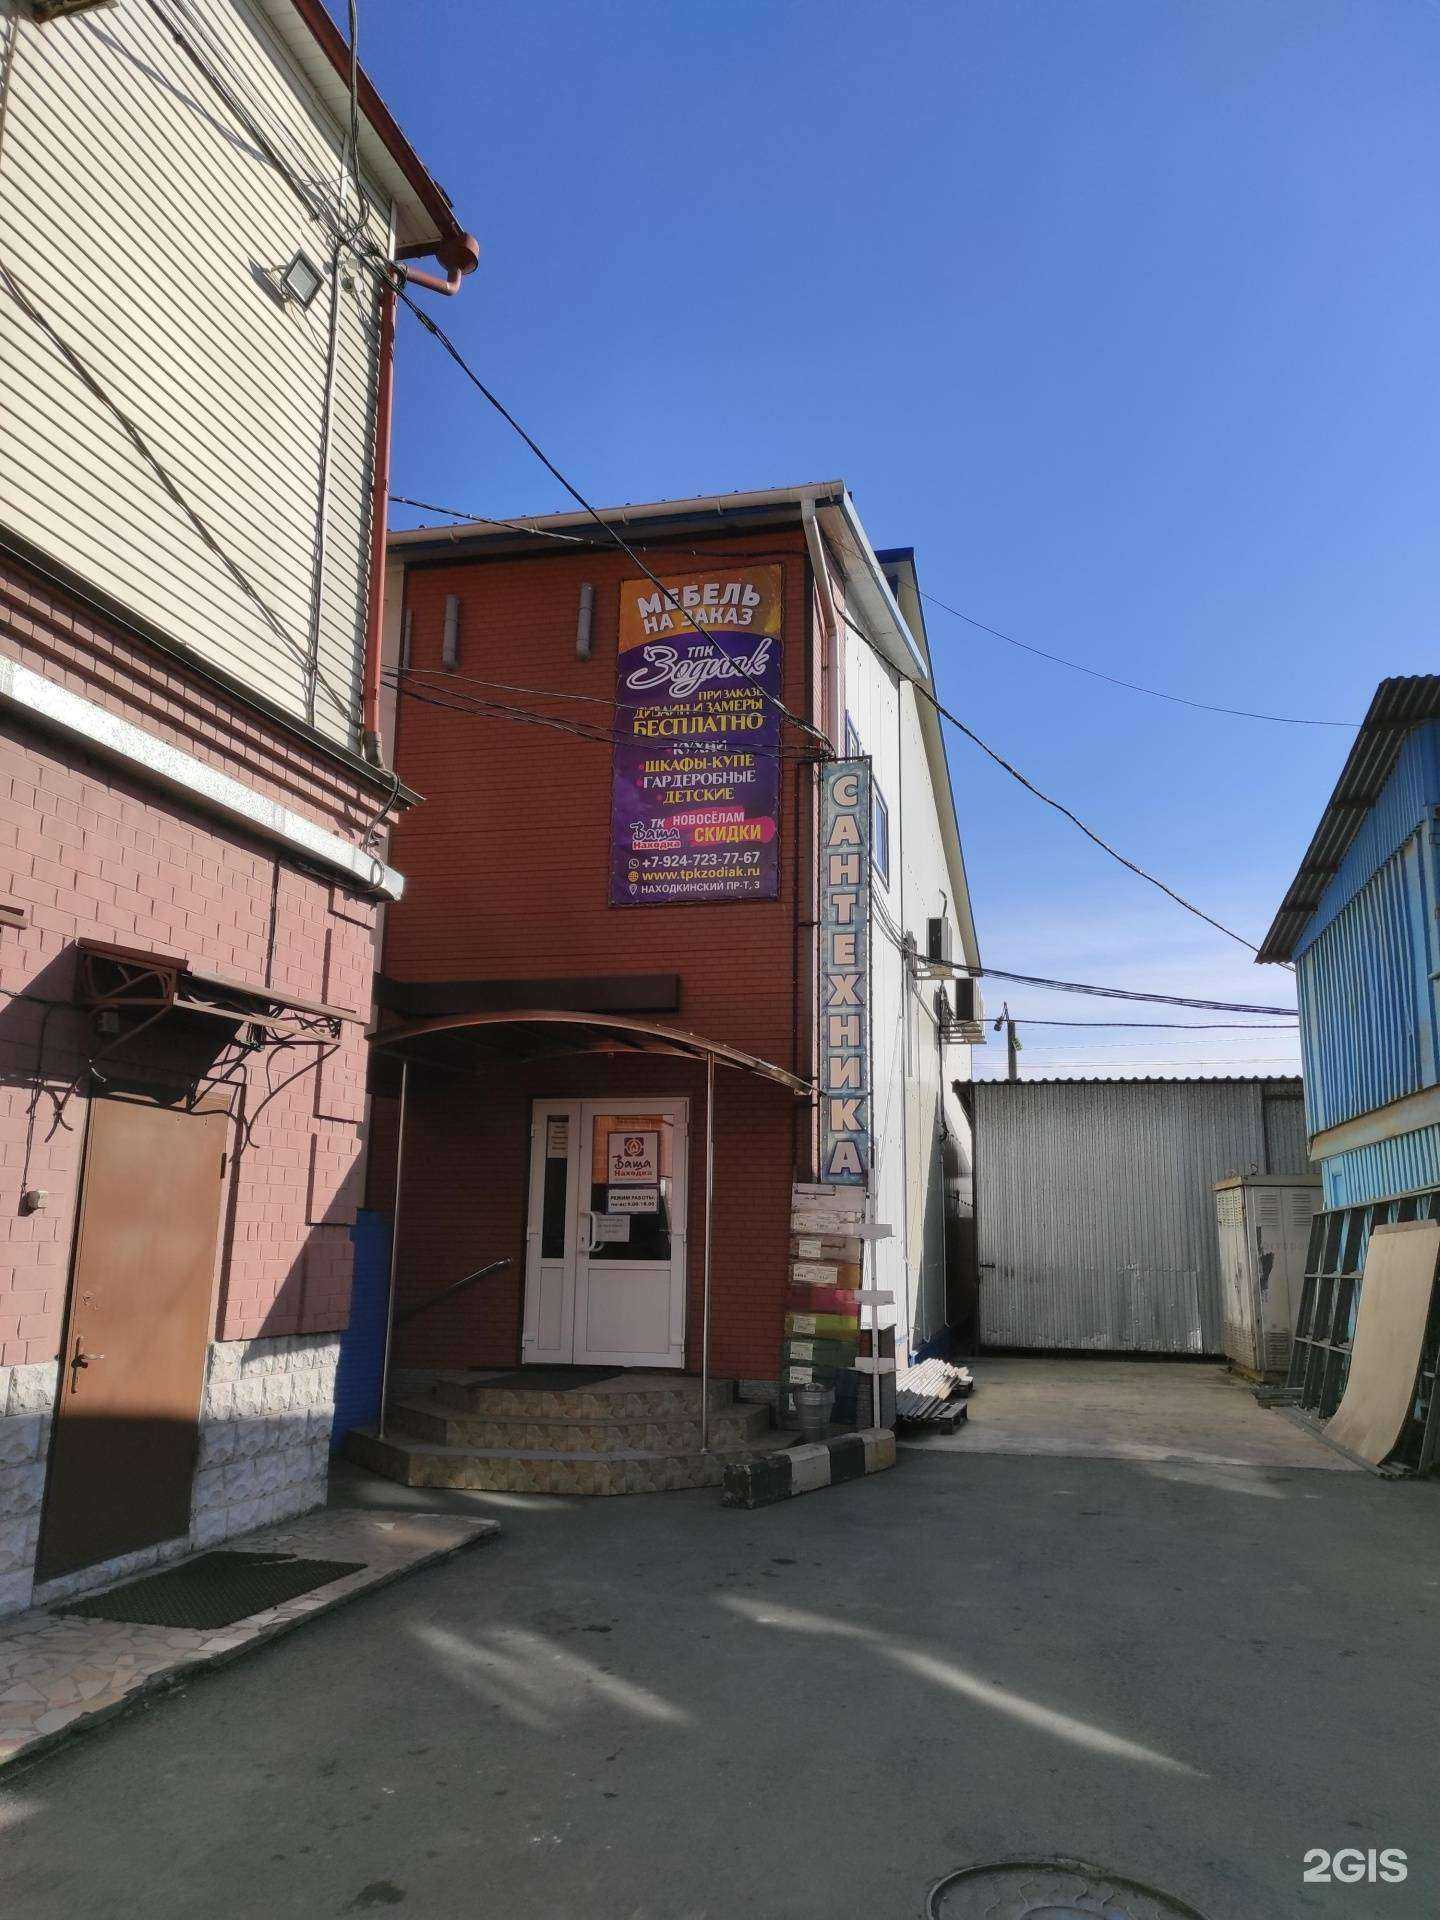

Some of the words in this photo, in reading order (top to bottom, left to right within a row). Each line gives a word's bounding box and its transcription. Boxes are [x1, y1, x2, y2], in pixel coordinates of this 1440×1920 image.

[637, 583, 761, 618] МЕБЕЛЬ
[644, 613, 674, 635] НА
[681, 608, 753, 628] ЗАКАЗ
[687, 645, 714, 659] ТПК
[697, 691, 722, 701] ПРИ
[724, 688, 764, 699] ЗАКАЗЕ
[693, 703, 702, 714] И
[706, 698, 763, 713] ЗАМЕРЫ
[633, 713, 765, 737] БЕСПЛАТНО
[644, 754, 755, 773] ШКАФЫ-КУПЕ
[643, 770, 756, 789] ГАРДЕРОБНЫЕ
[663, 788, 735, 805] ДЕТСКИЕ
[651, 818, 665, 828] ТК
[673, 811, 745, 826] НОВОСЁЛАМ
[630, 821, 680, 841] Ваша
[694, 825, 761, 844] СКИДКИ
[632, 840, 681, 851] Находка
[642, 852, 760, 869] +7-924-723-77-67
[642, 867, 760, 882] www.tpkzodiak.ru
[641, 881, 724, 894] НАХОДКИНСКИЙ
[827, 774, 863, 1176] САНТЕХНИКА
